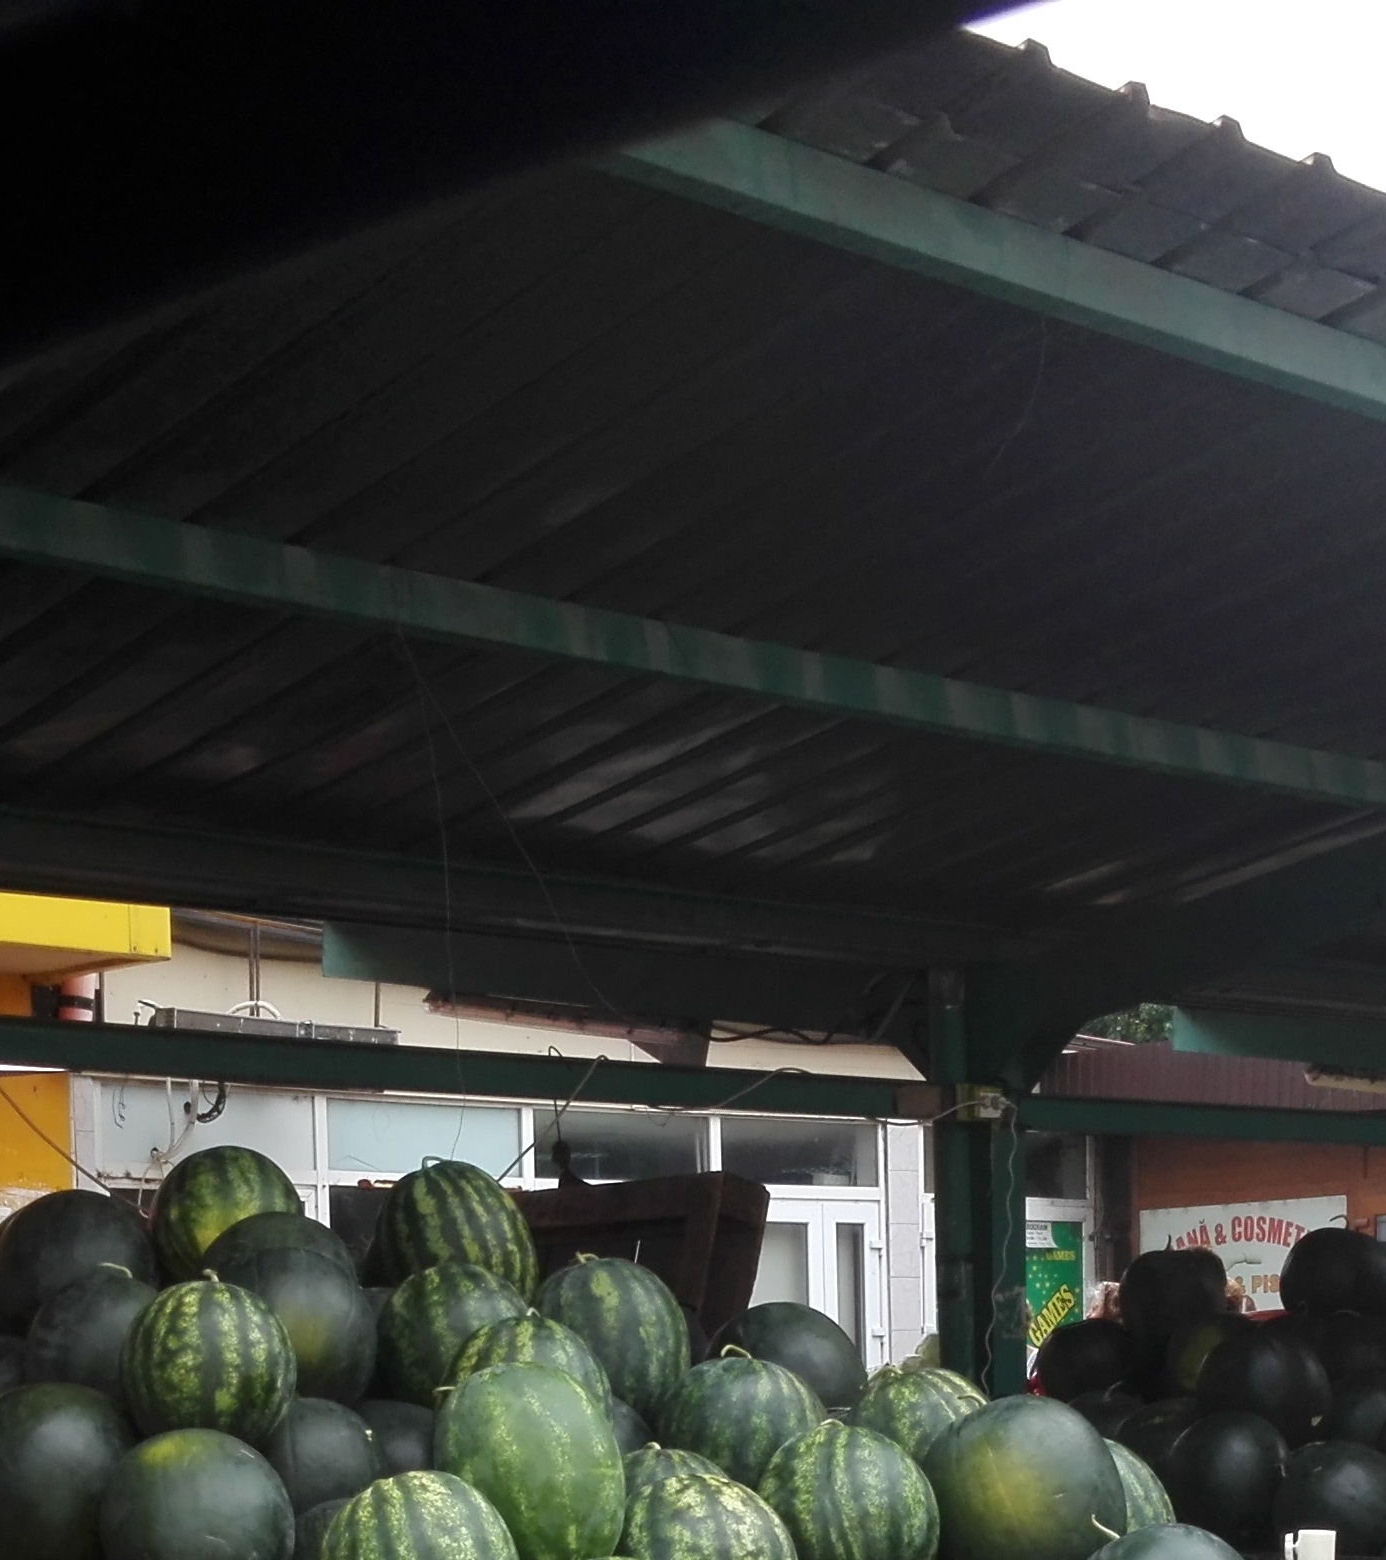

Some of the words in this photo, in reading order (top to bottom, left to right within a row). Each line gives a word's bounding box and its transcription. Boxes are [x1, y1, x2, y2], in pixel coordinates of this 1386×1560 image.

[1175, 1218, 1210, 1250] ANĂ
[1215, 1223, 1226, 1246] &
[1231, 1216, 1306, 1247] COSMET
[1251, 1274, 1280, 1294] PIS
[1028, 1283, 1075, 1348] GAMES
